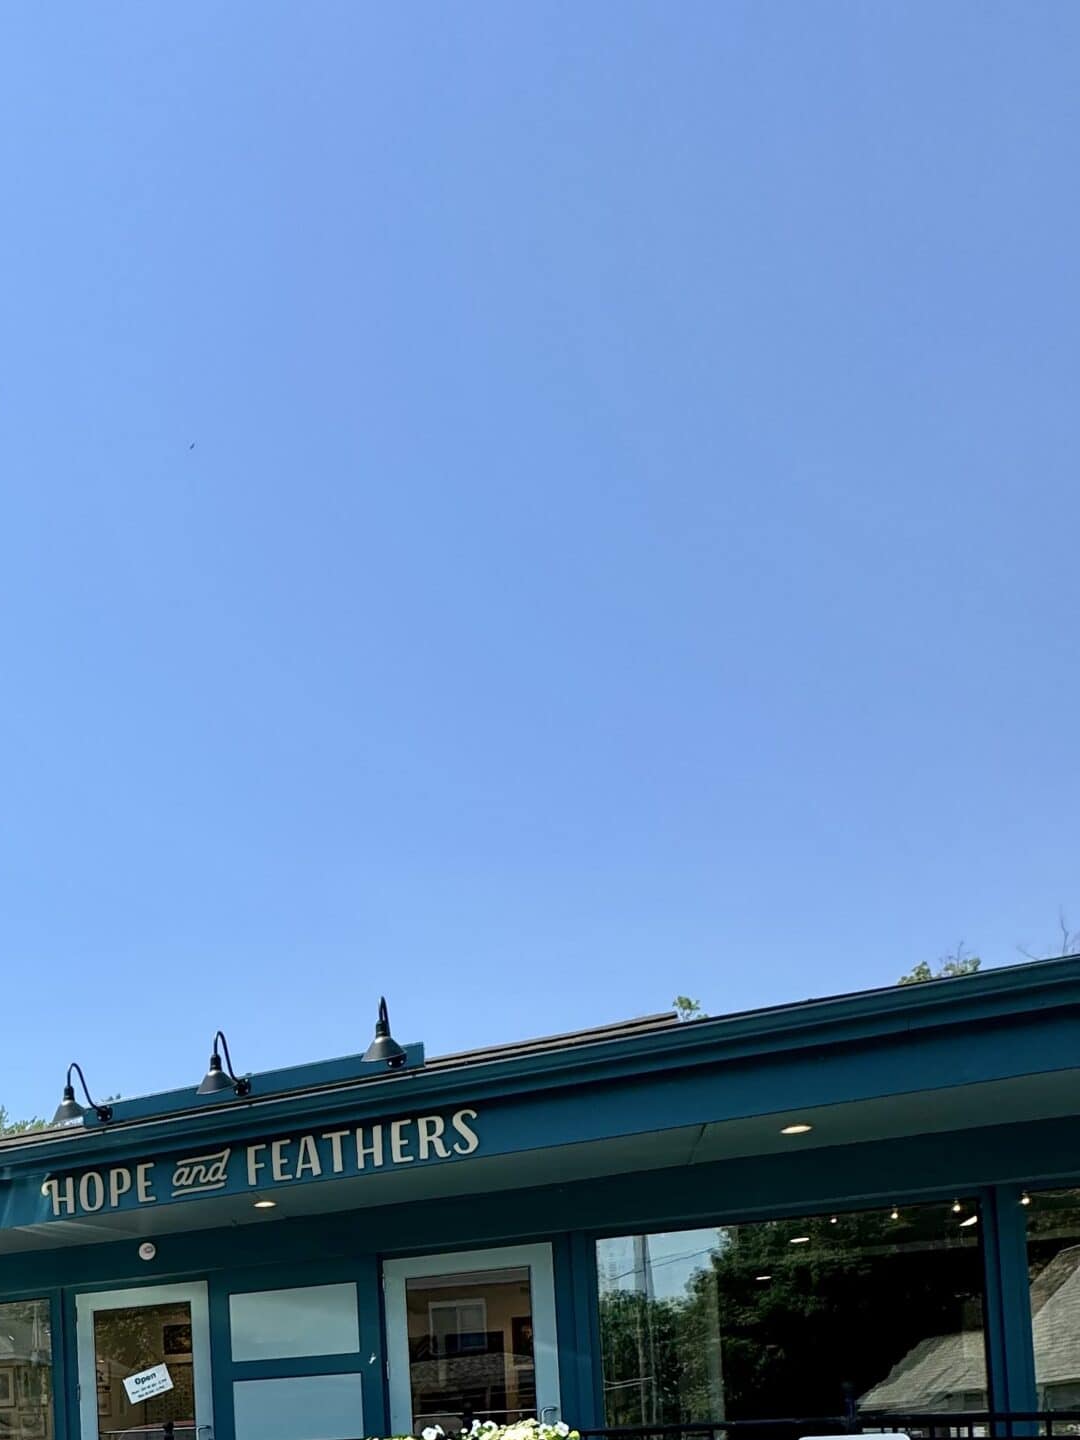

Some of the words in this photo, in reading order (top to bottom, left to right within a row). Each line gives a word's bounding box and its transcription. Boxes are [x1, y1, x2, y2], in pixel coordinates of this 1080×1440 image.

[40, 1161, 157, 1217] HOPE
[171, 1148, 231, 1198] and
[246, 1108, 481, 1187] FEATHERS
[134, 1372, 157, 1385] Open
